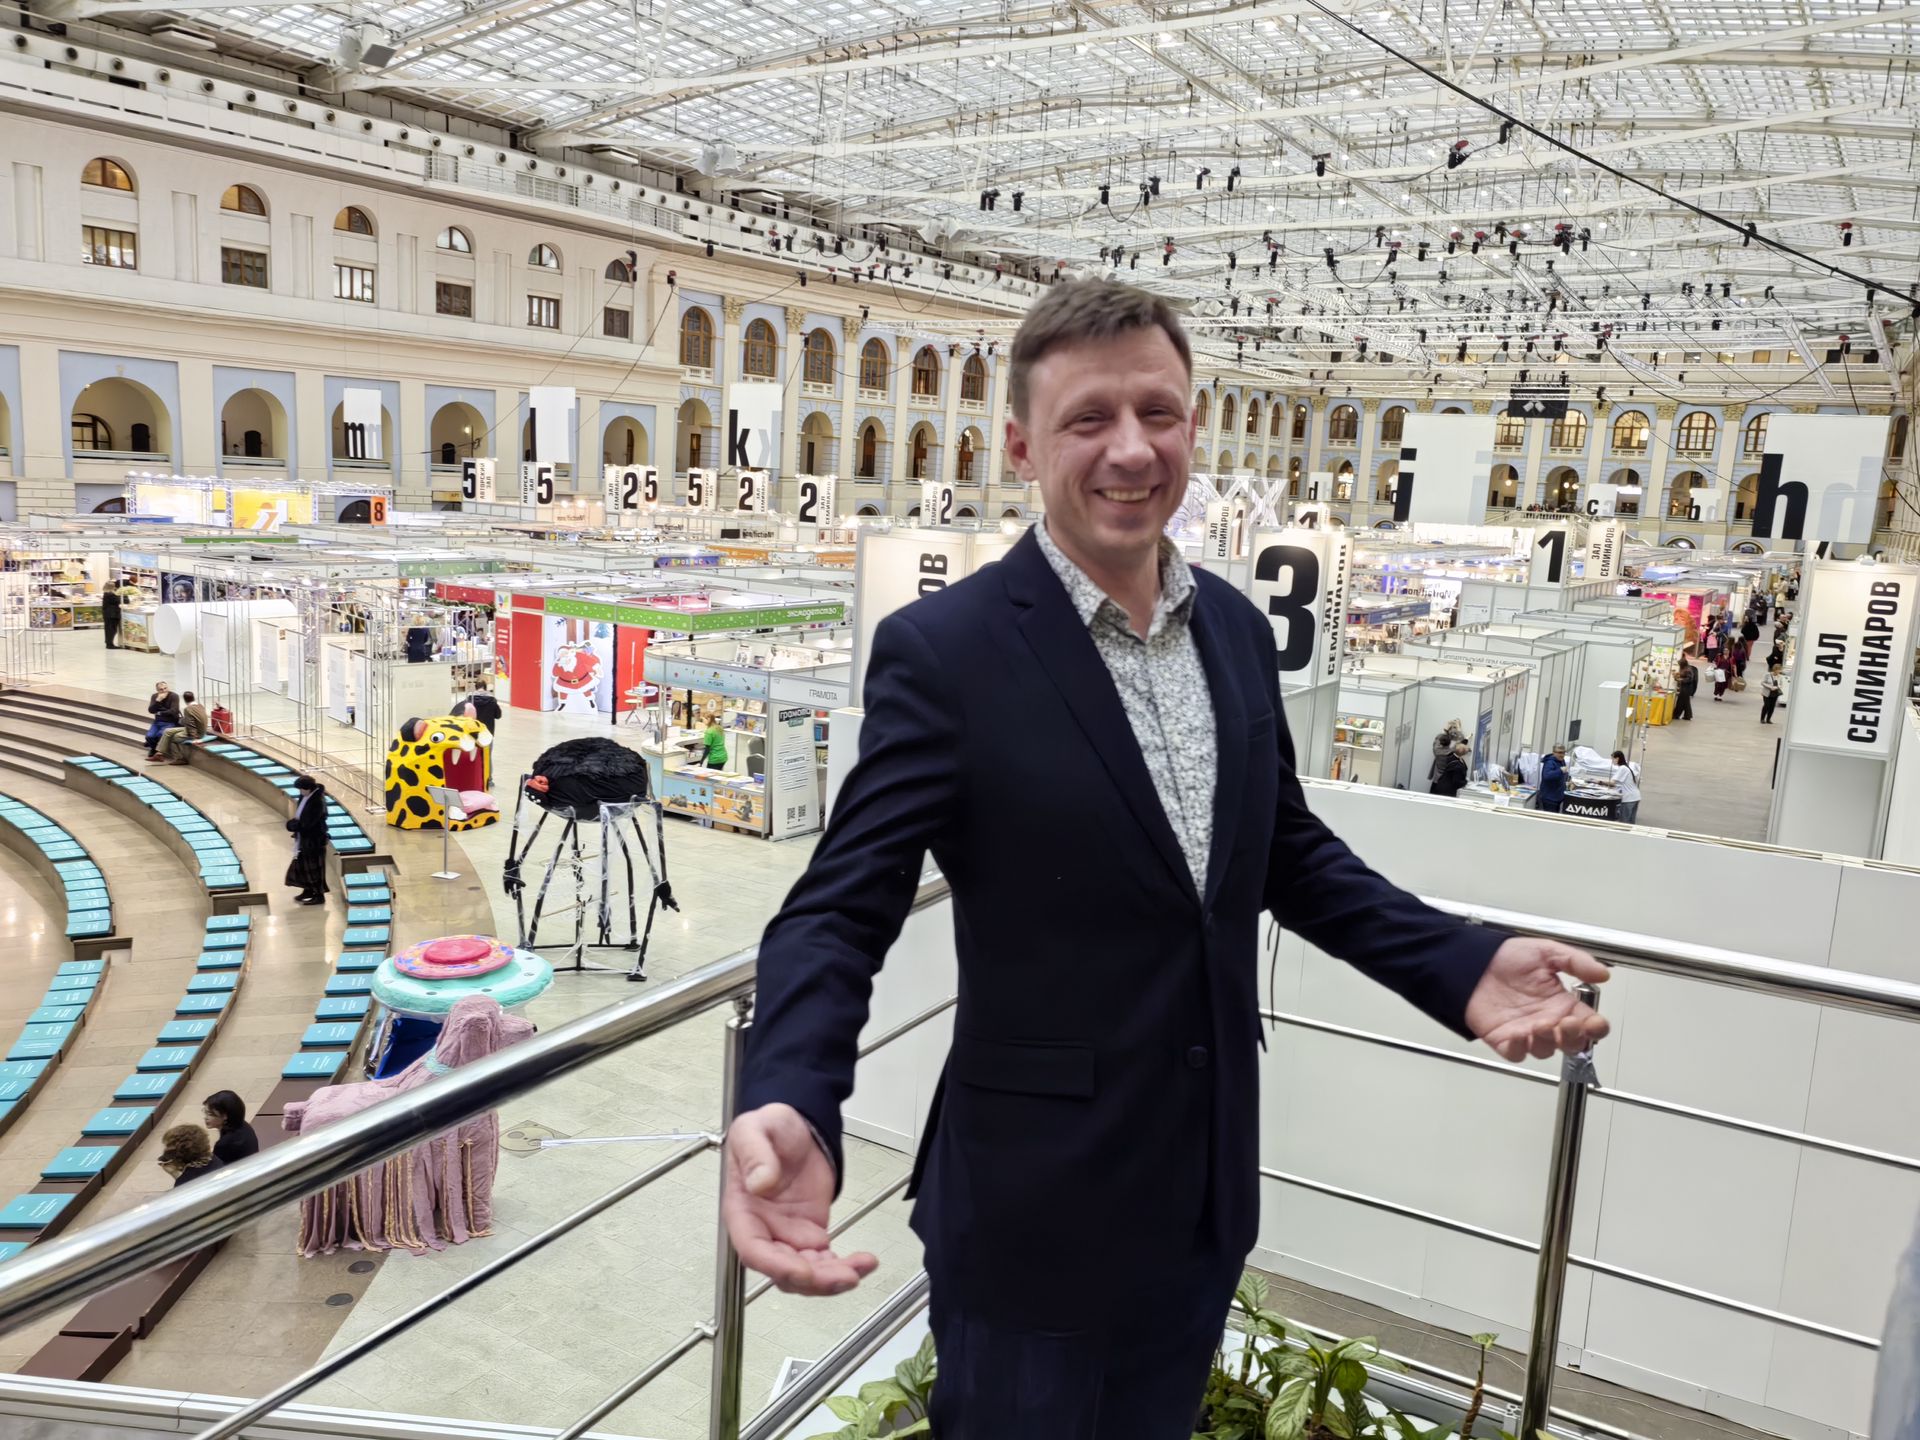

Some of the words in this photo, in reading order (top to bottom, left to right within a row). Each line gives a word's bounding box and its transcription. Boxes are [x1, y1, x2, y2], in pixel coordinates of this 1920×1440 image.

[463, 462, 476, 499] 5
[537, 467, 553, 504] 5
[623, 472, 638, 509] 2
[645, 471, 657, 502] 5
[688, 473, 702, 506] 5
[739, 476, 753, 511] 2
[1752, 453, 1809, 540] h
[374, 501, 384, 522] 8
[799, 482, 817, 523] 2
[941, 488, 952, 524] 2
[1209, 522, 1218, 540] ЗАЛ
[1218, 506, 1230, 557] СЕМИНАРОВ
[1537, 530, 1566, 583] 1
[1591, 543, 1601, 560] ЗАЛ
[1600, 527, 1615, 577] СЕМИНАРОВ
[1255, 545, 1319, 672] 3
[1812, 632, 1848, 686] ЗАЛ
[1847, 581, 1901, 744] СЕМИНАРОВ
[809, 688, 838, 701] ГРАМОТА
[1565, 804, 1608, 816] ДУМАЙ
